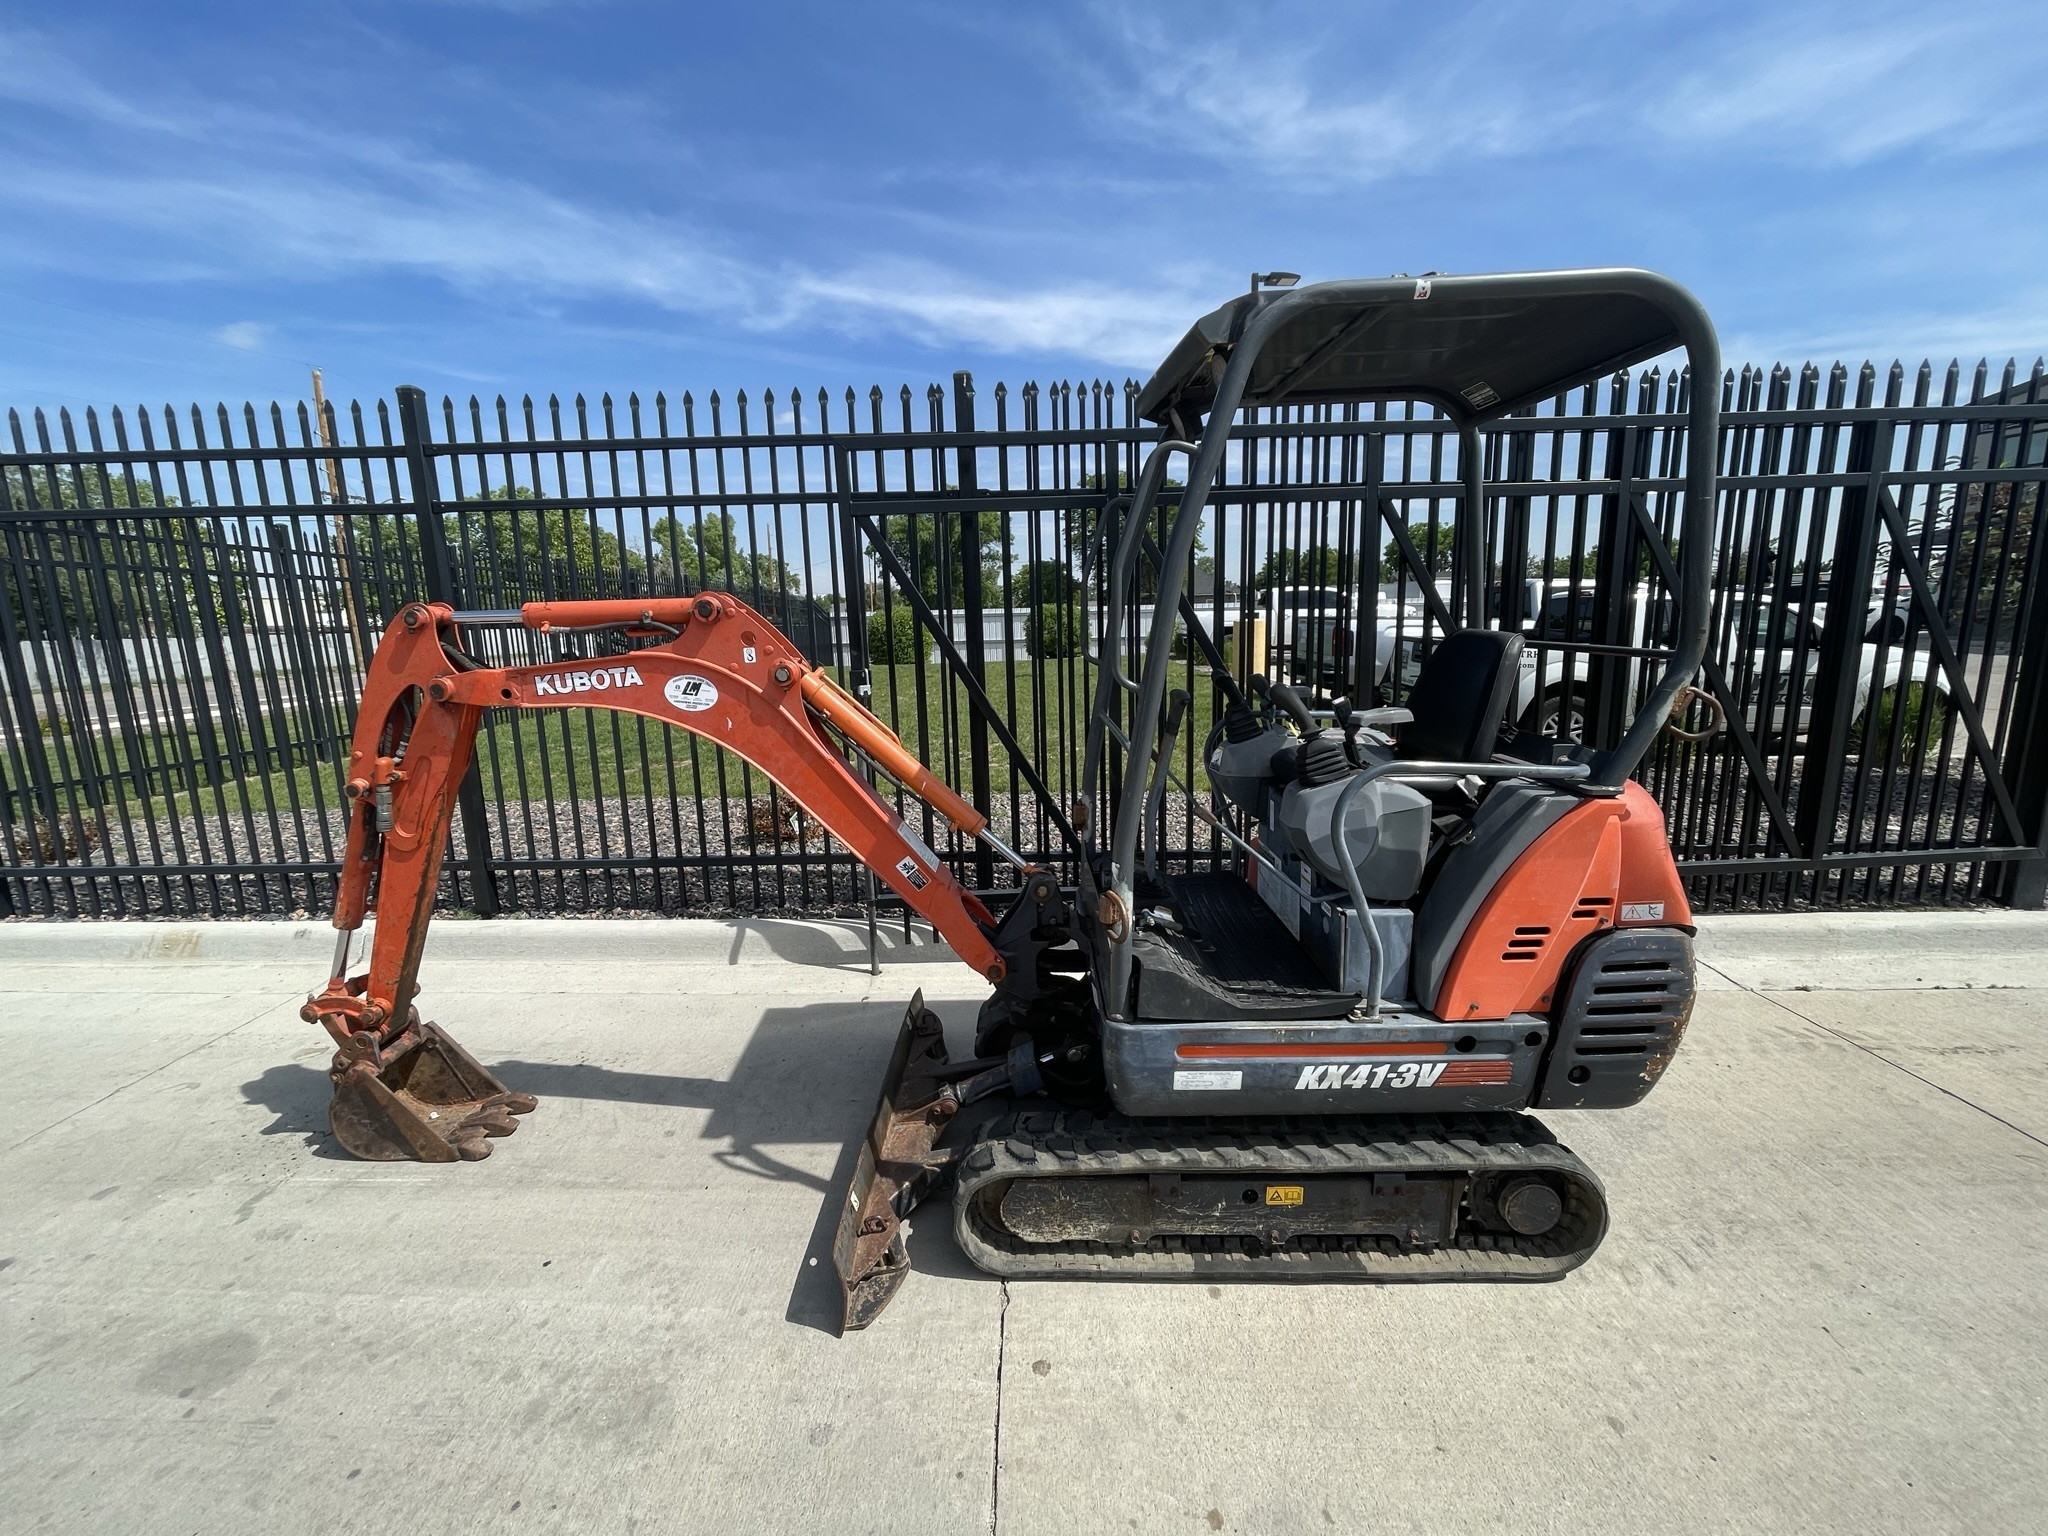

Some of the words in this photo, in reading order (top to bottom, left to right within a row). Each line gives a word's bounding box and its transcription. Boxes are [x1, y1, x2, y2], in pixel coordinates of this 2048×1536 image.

[534, 666, 644, 696] KUBOTA
[681, 681, 702, 696] LM
[1294, 1062, 1449, 1090] KX41-3V
